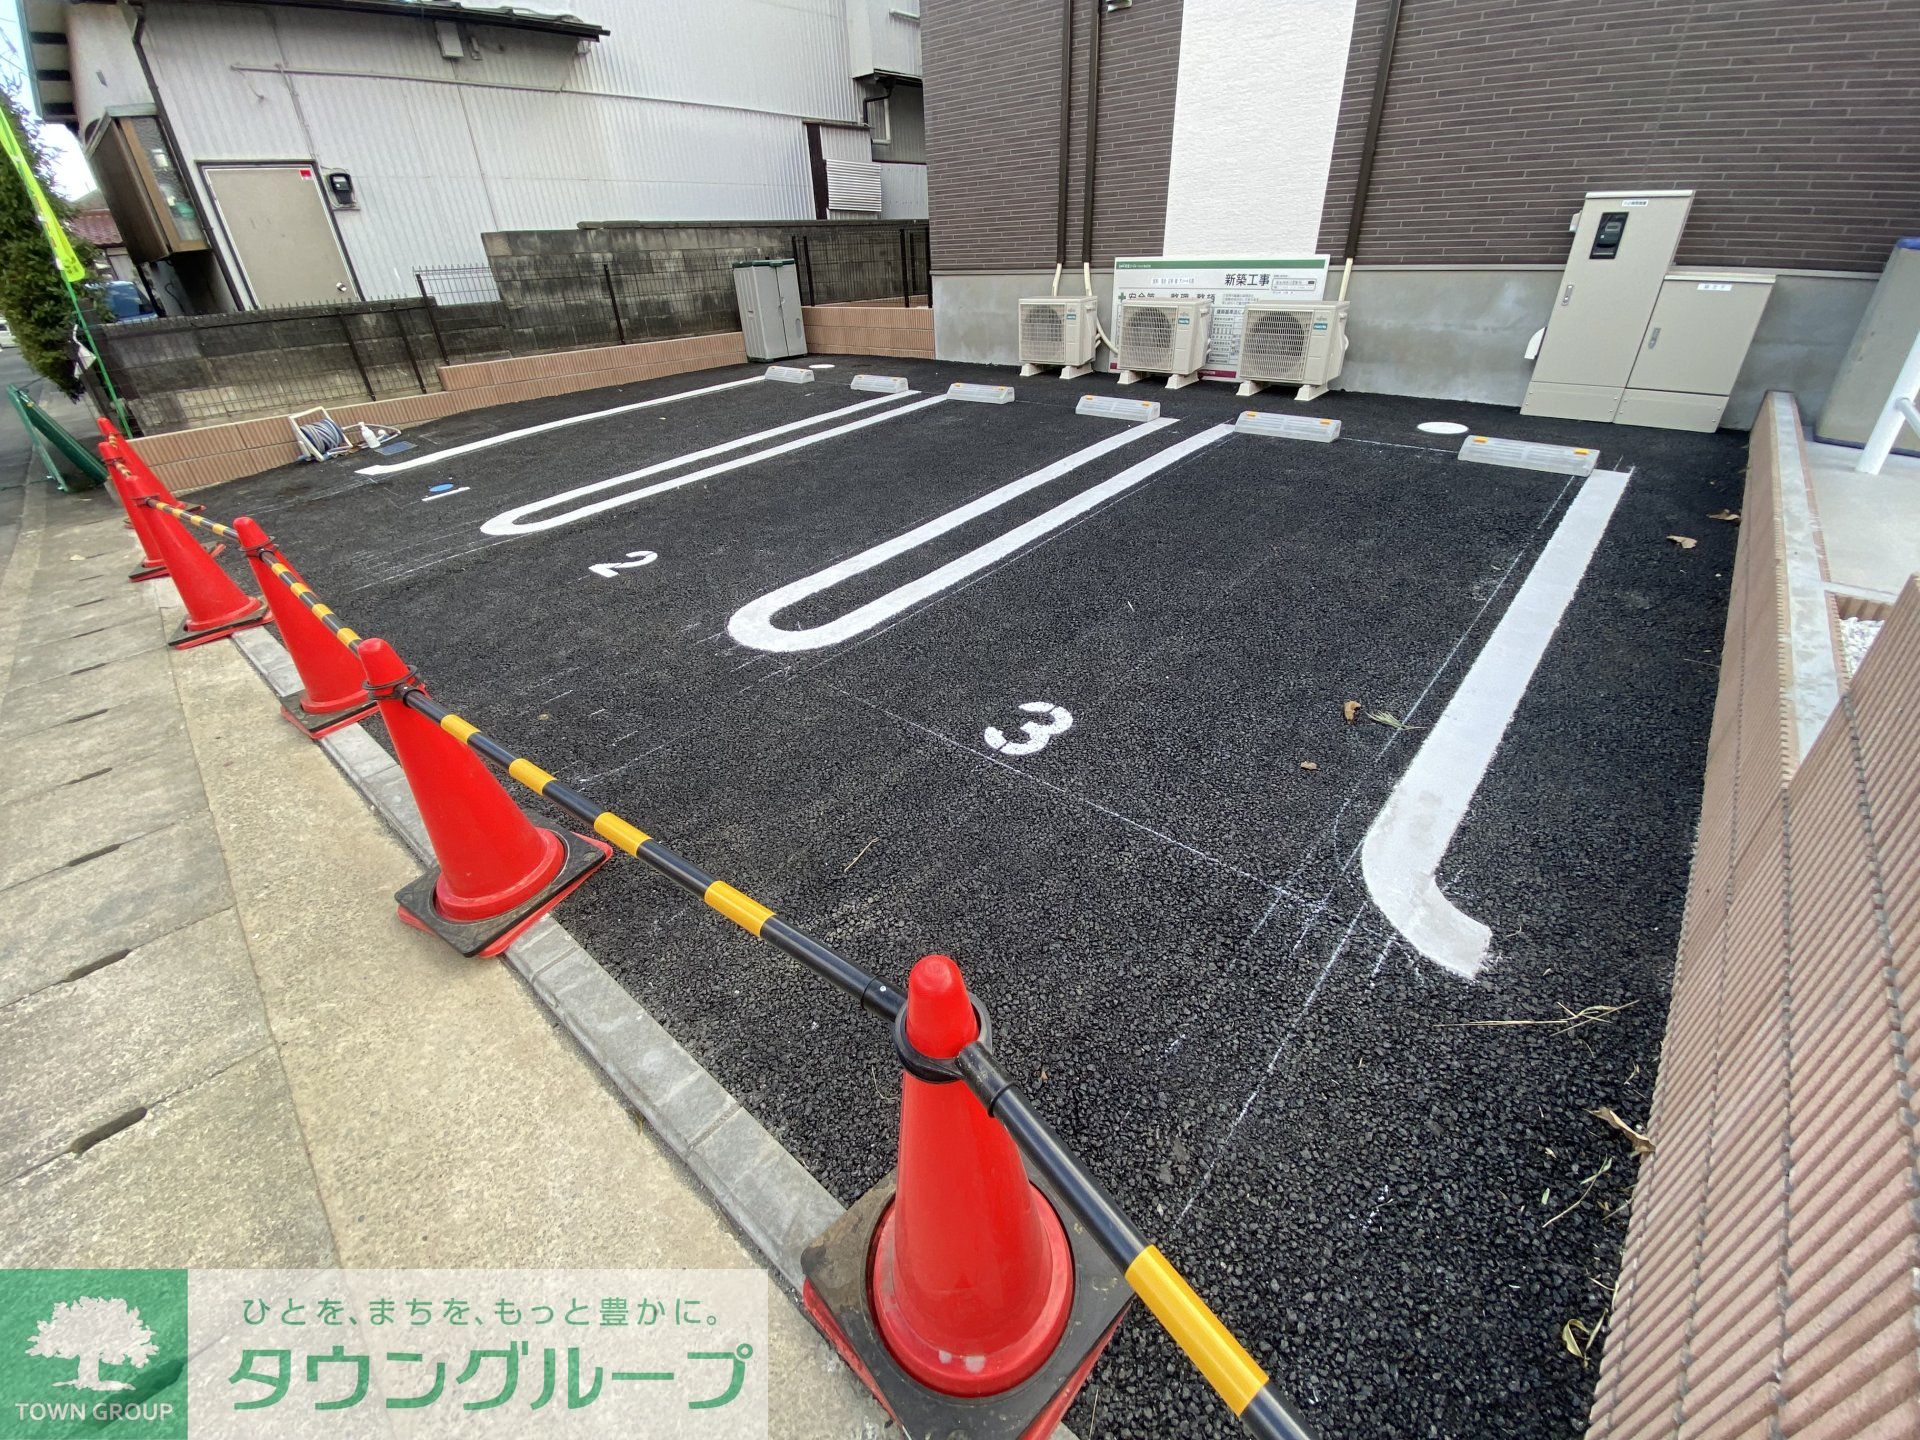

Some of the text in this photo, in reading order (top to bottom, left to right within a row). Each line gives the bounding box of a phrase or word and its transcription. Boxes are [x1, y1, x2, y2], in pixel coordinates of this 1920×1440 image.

[1224, 273, 1270, 287] 新築工事
[588, 550, 658, 578] 2
[984, 701, 1073, 755] 3
